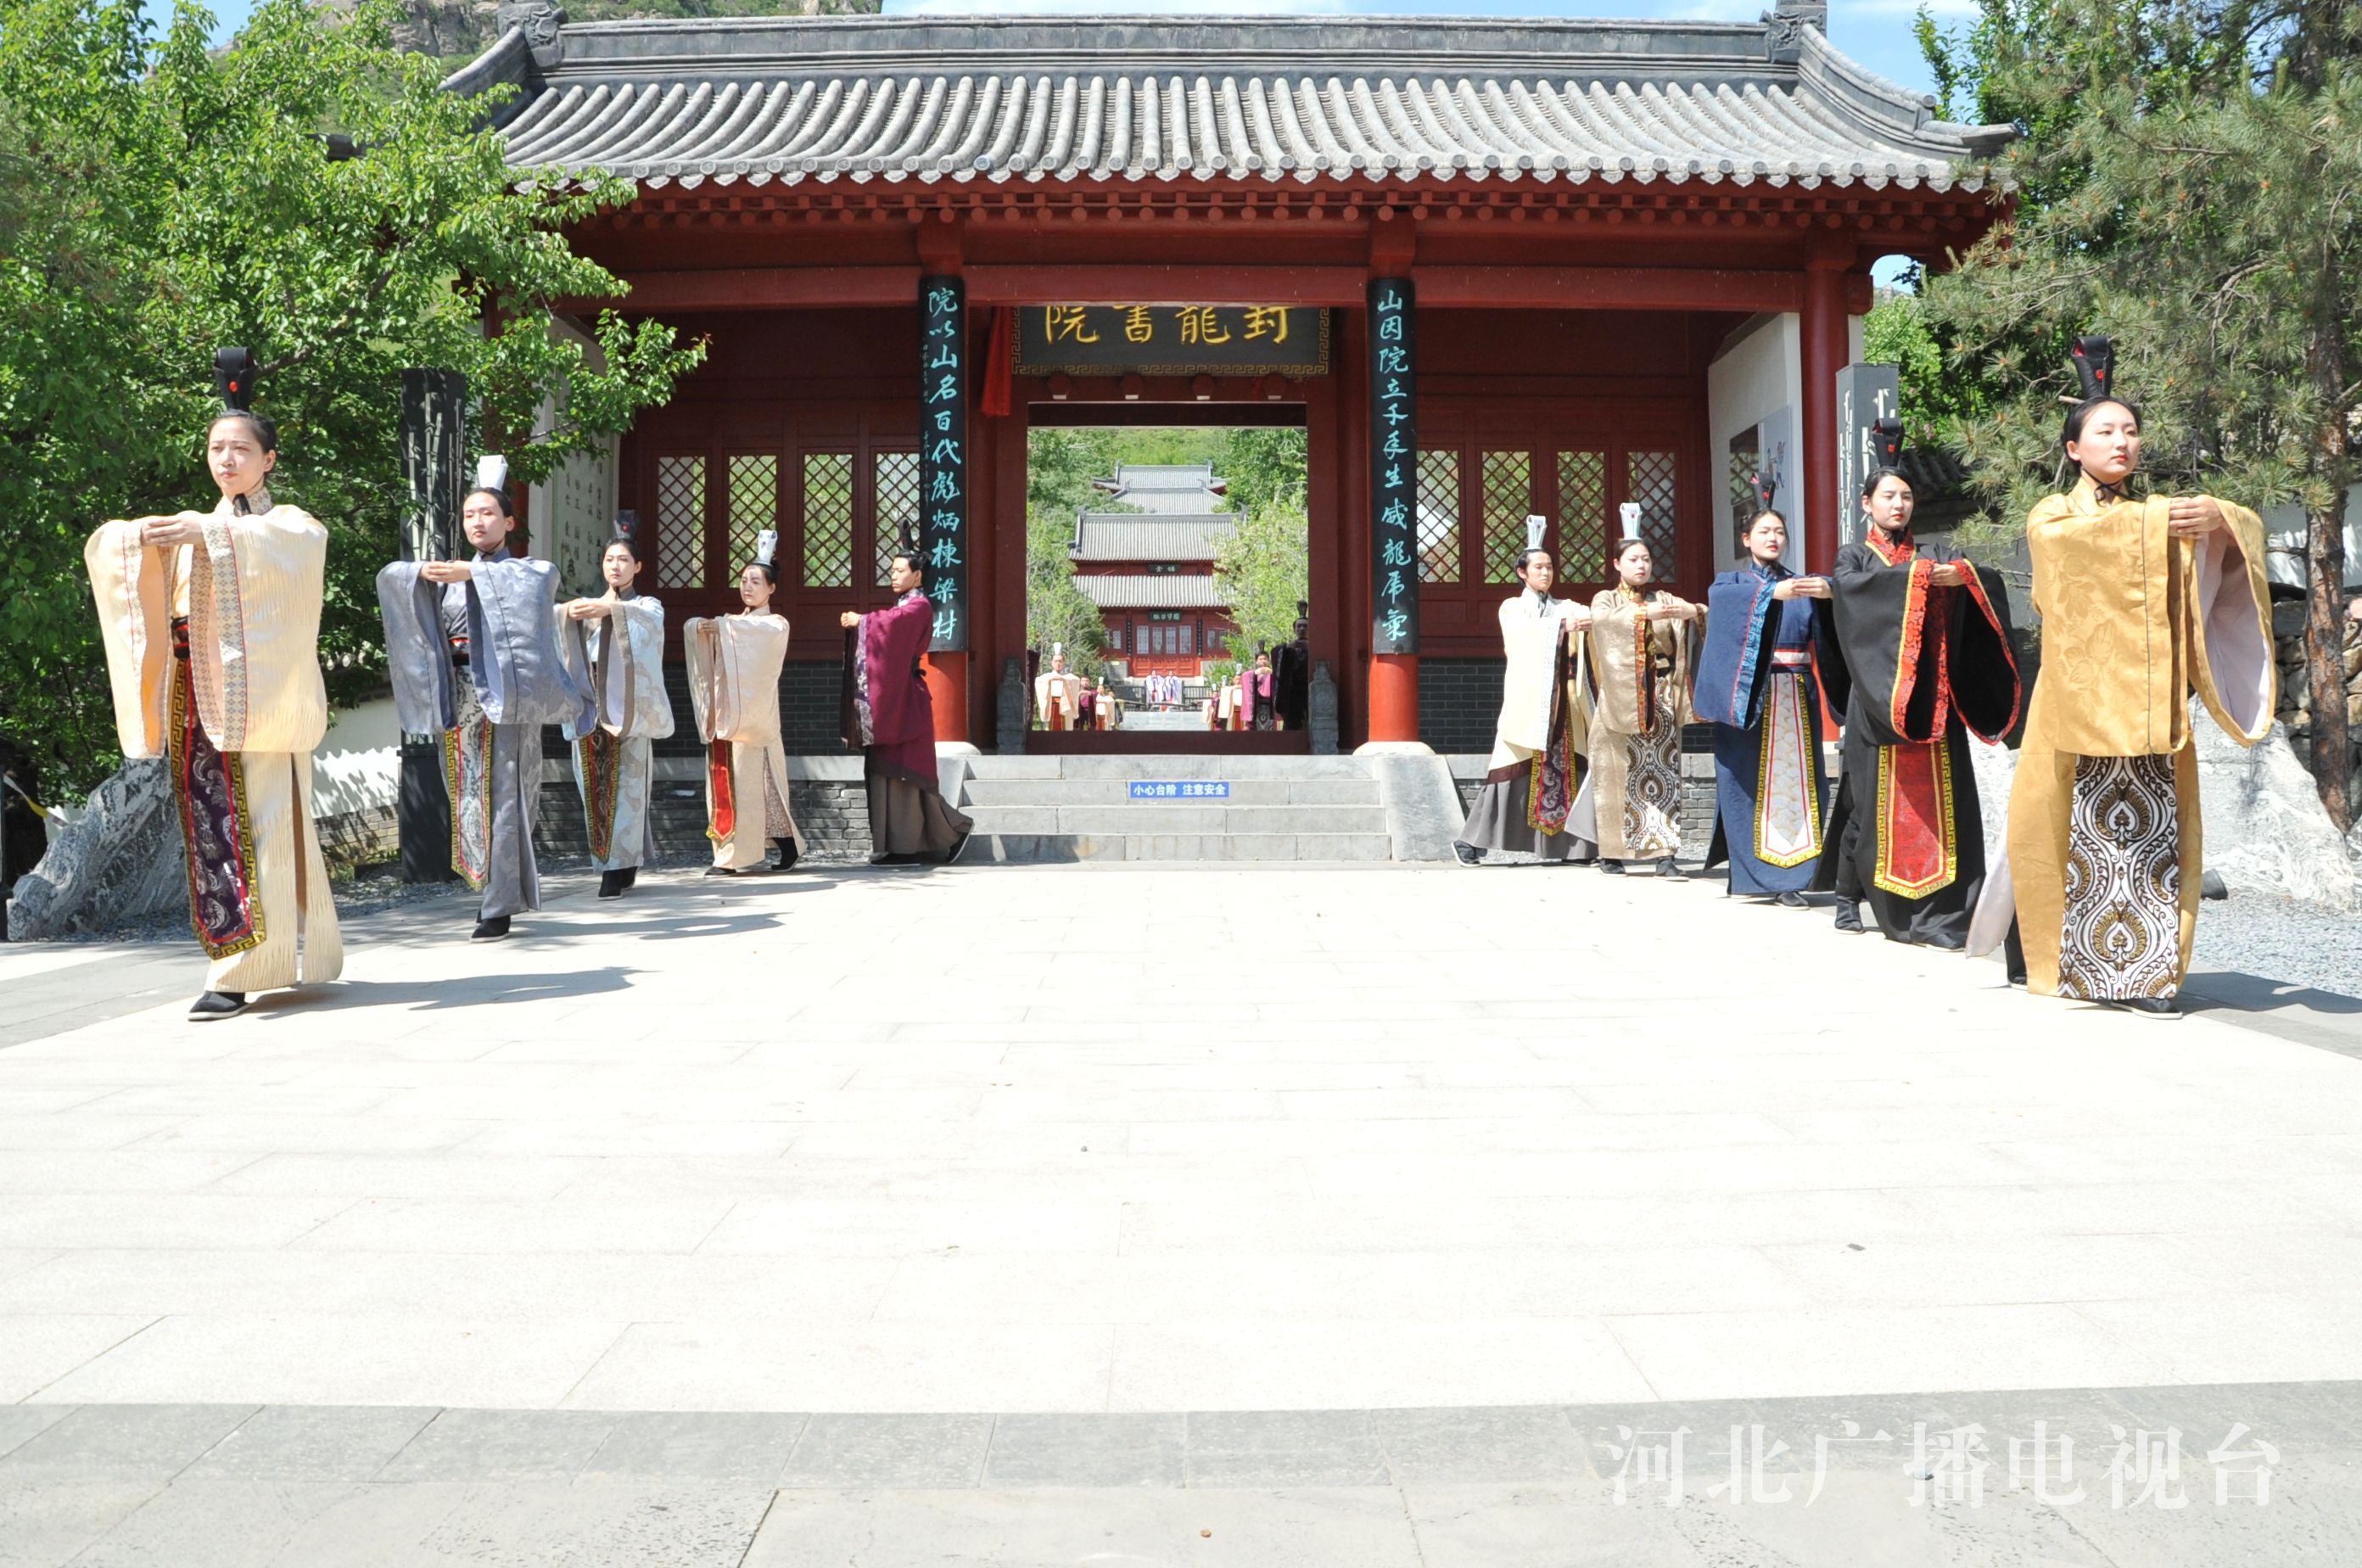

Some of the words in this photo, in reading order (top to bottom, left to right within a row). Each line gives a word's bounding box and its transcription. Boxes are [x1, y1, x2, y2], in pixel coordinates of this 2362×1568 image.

[1133, 784, 1177, 796] 小心台阶
[1183, 784, 1226, 796] 注意安全
